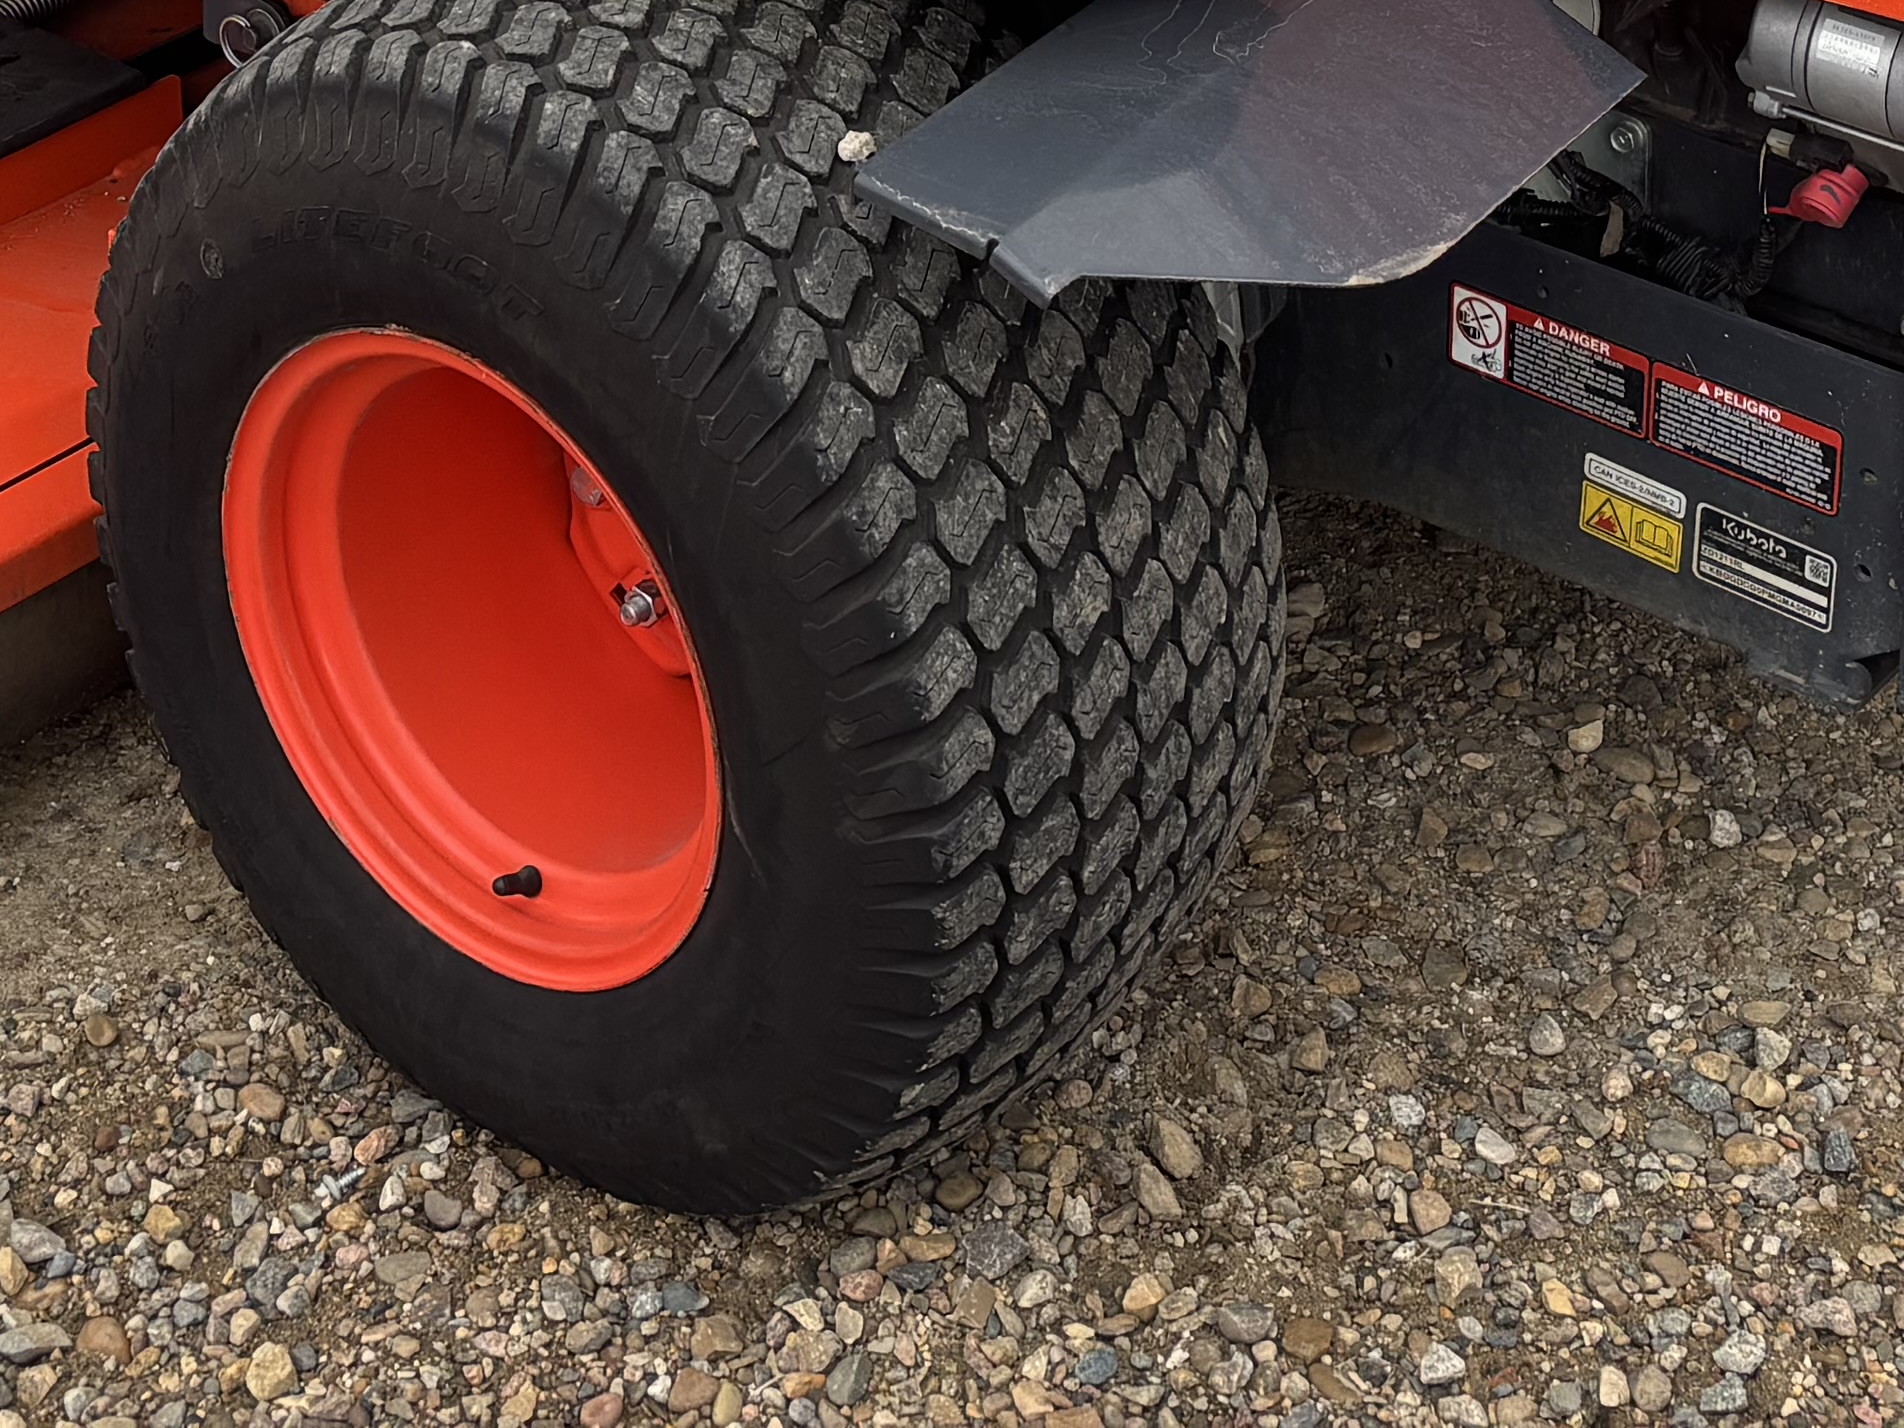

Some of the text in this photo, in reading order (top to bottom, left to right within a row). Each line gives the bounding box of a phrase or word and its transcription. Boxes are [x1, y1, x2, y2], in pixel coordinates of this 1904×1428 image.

[1548, 321, 1612, 356] DANGER
[1713, 385, 1782, 424] PELIGRO
[1722, 518, 1787, 559] Kubota
